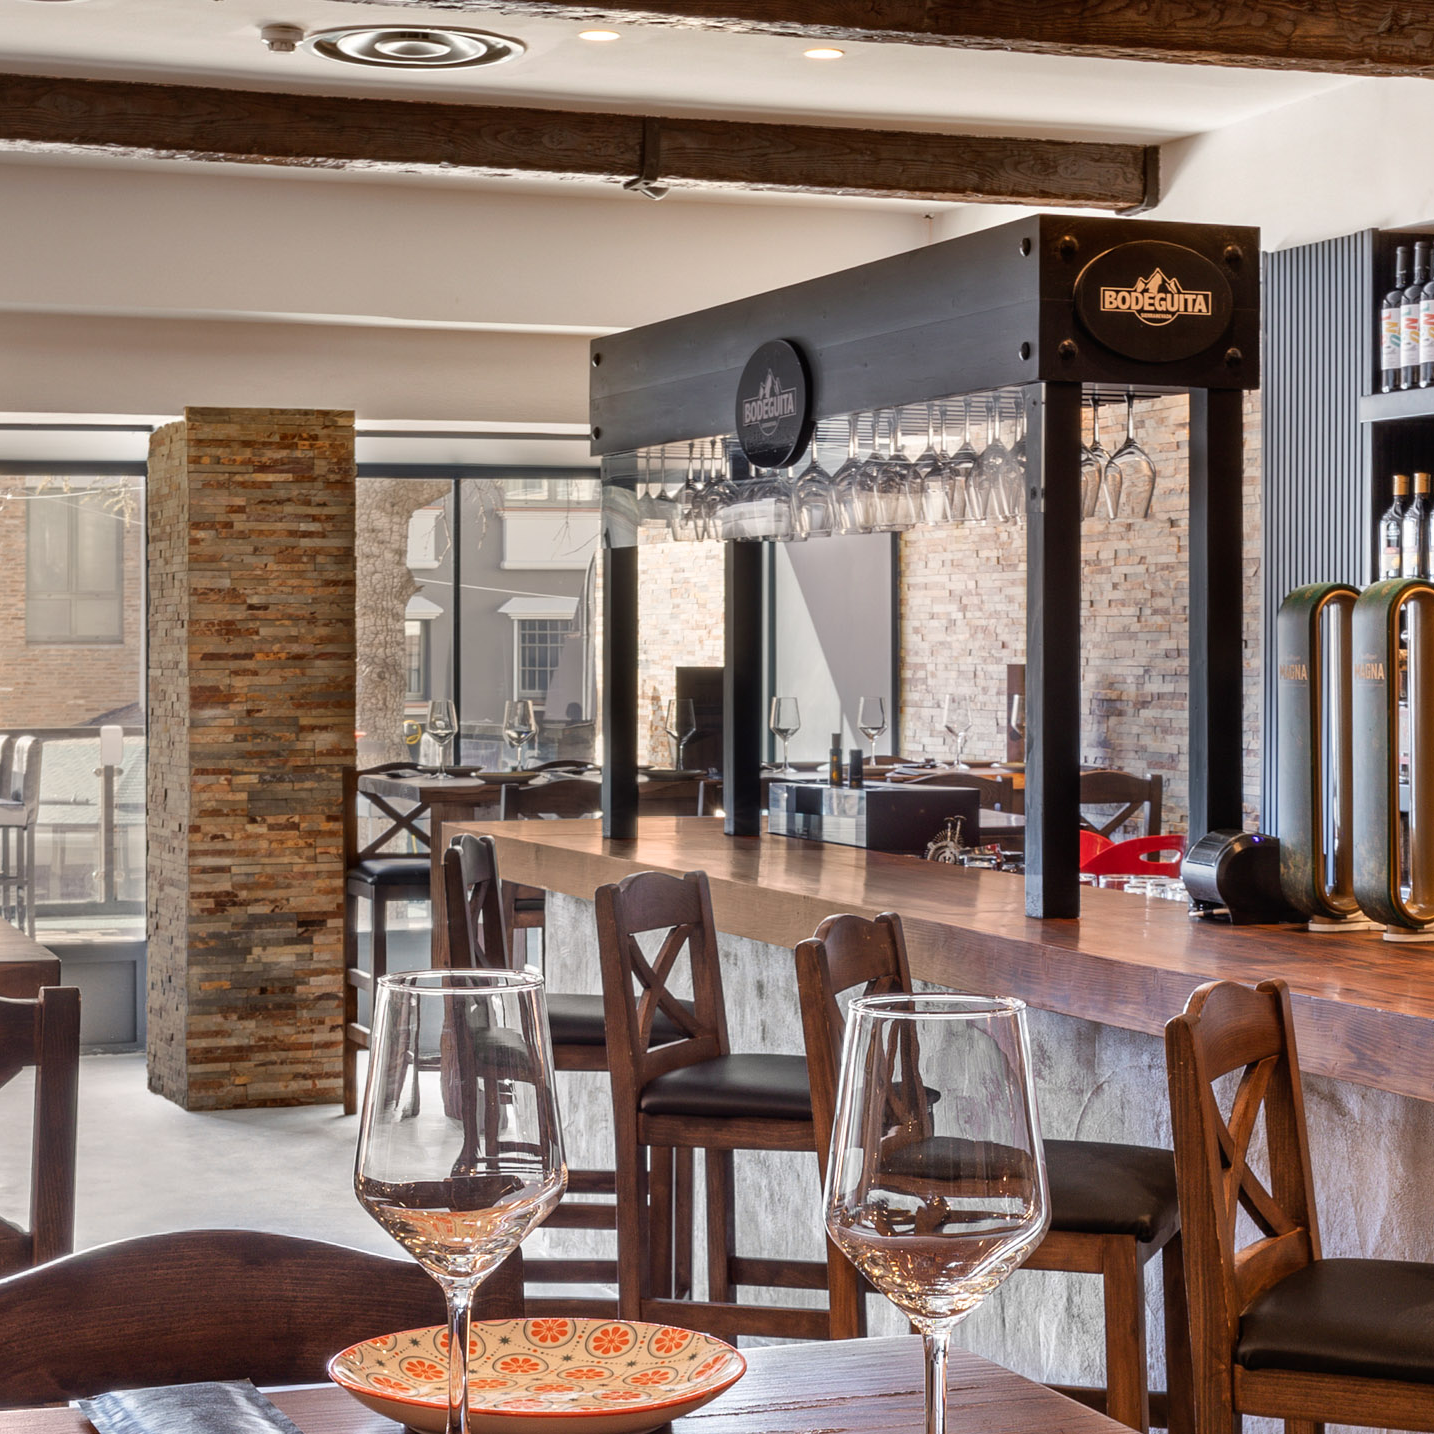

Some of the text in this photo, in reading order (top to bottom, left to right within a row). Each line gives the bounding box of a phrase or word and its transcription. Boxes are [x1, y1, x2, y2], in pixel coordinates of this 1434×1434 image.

[1104, 290, 1208, 313] BODEGUITA
[744, 393, 795, 423] BODEGUITA
[1279, 664, 1308, 680] MAGNA
[1354, 663, 1385, 680] MAGNA
